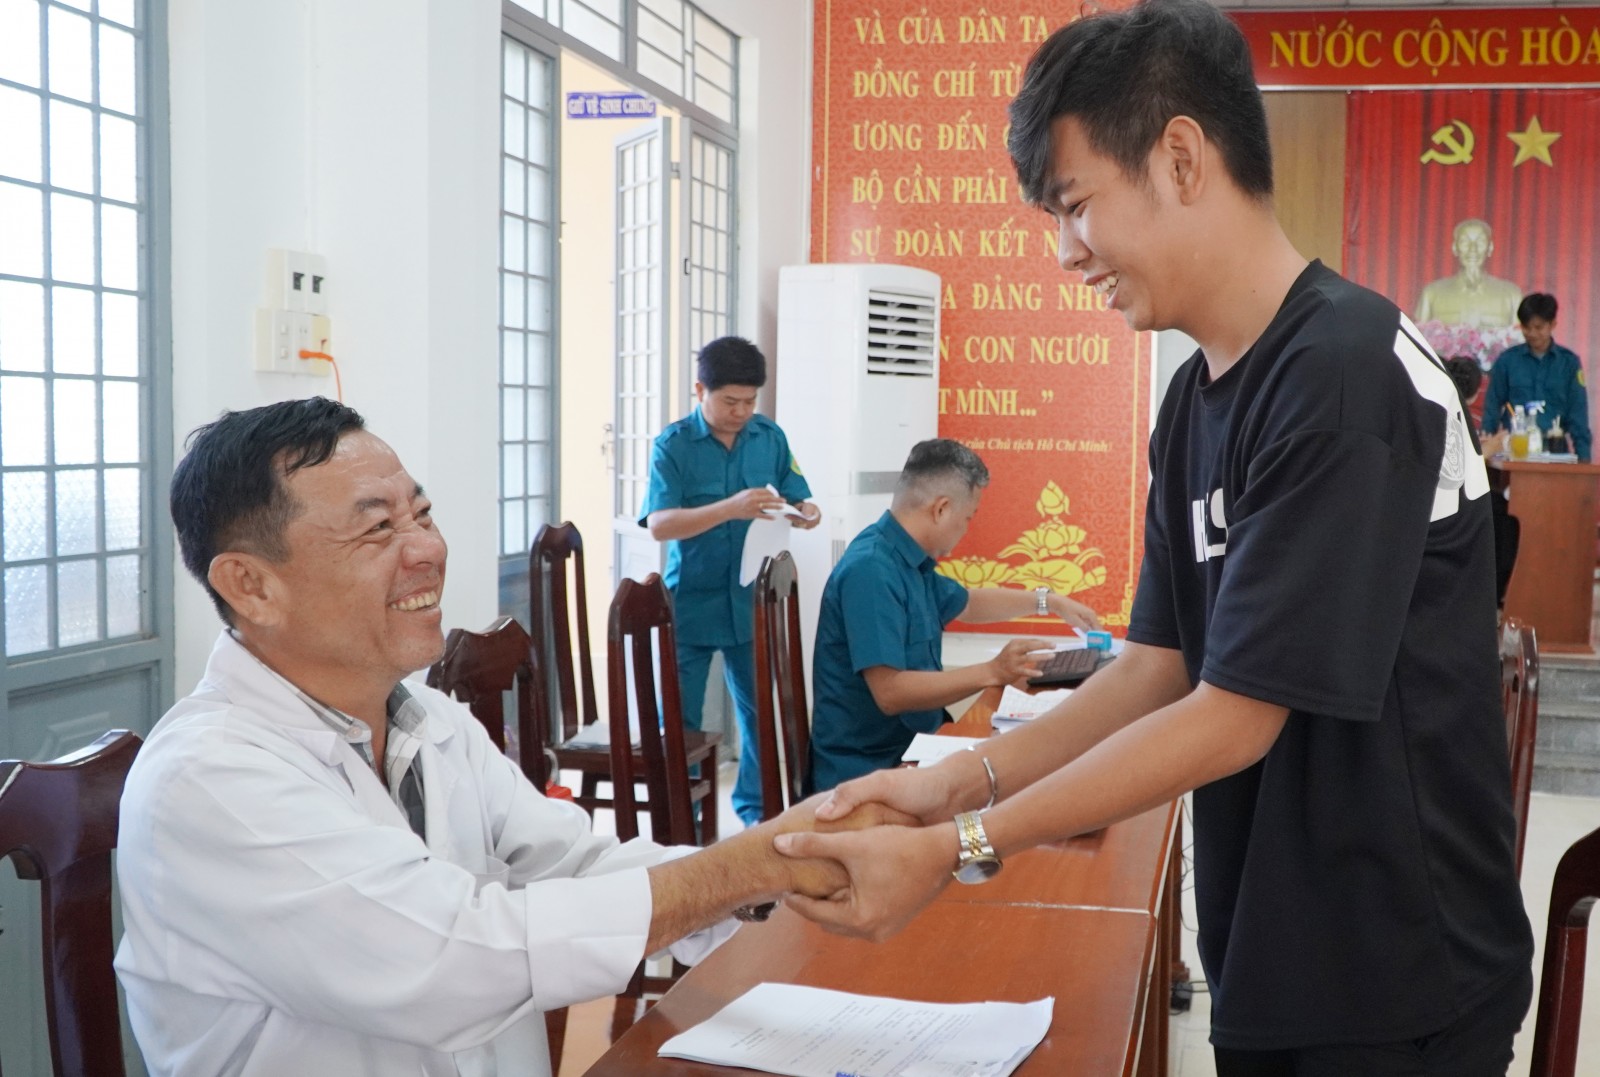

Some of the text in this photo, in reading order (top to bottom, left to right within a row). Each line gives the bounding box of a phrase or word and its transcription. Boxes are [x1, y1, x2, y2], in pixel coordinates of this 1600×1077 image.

[855, 10, 886, 44] VÀ
[899, 8, 946, 44] CỦA
[958, 8, 1007, 44] DÂN
[1018, 15, 1049, 43] TA
[1269, 16, 1600, 77] NƯỚC CỘNG HÒA
[854, 57, 1022, 98] ĐỒNG CHÍ TỪ
[853, 120, 923, 151] ƯƠNG
[937, 110, 988, 150] ĐẾN
[852, 168, 884, 211] BỘ
[893, 162, 942, 204] CẦN
[952, 166, 1008, 204] PHẢI
[850, 225, 881, 263] SỰ
[894, 222, 964, 257] ĐOÀN
[978, 217, 1029, 258] KẾT
[972, 274, 1043, 311] ĐẢNG
[964, 334, 1016, 364] CON
